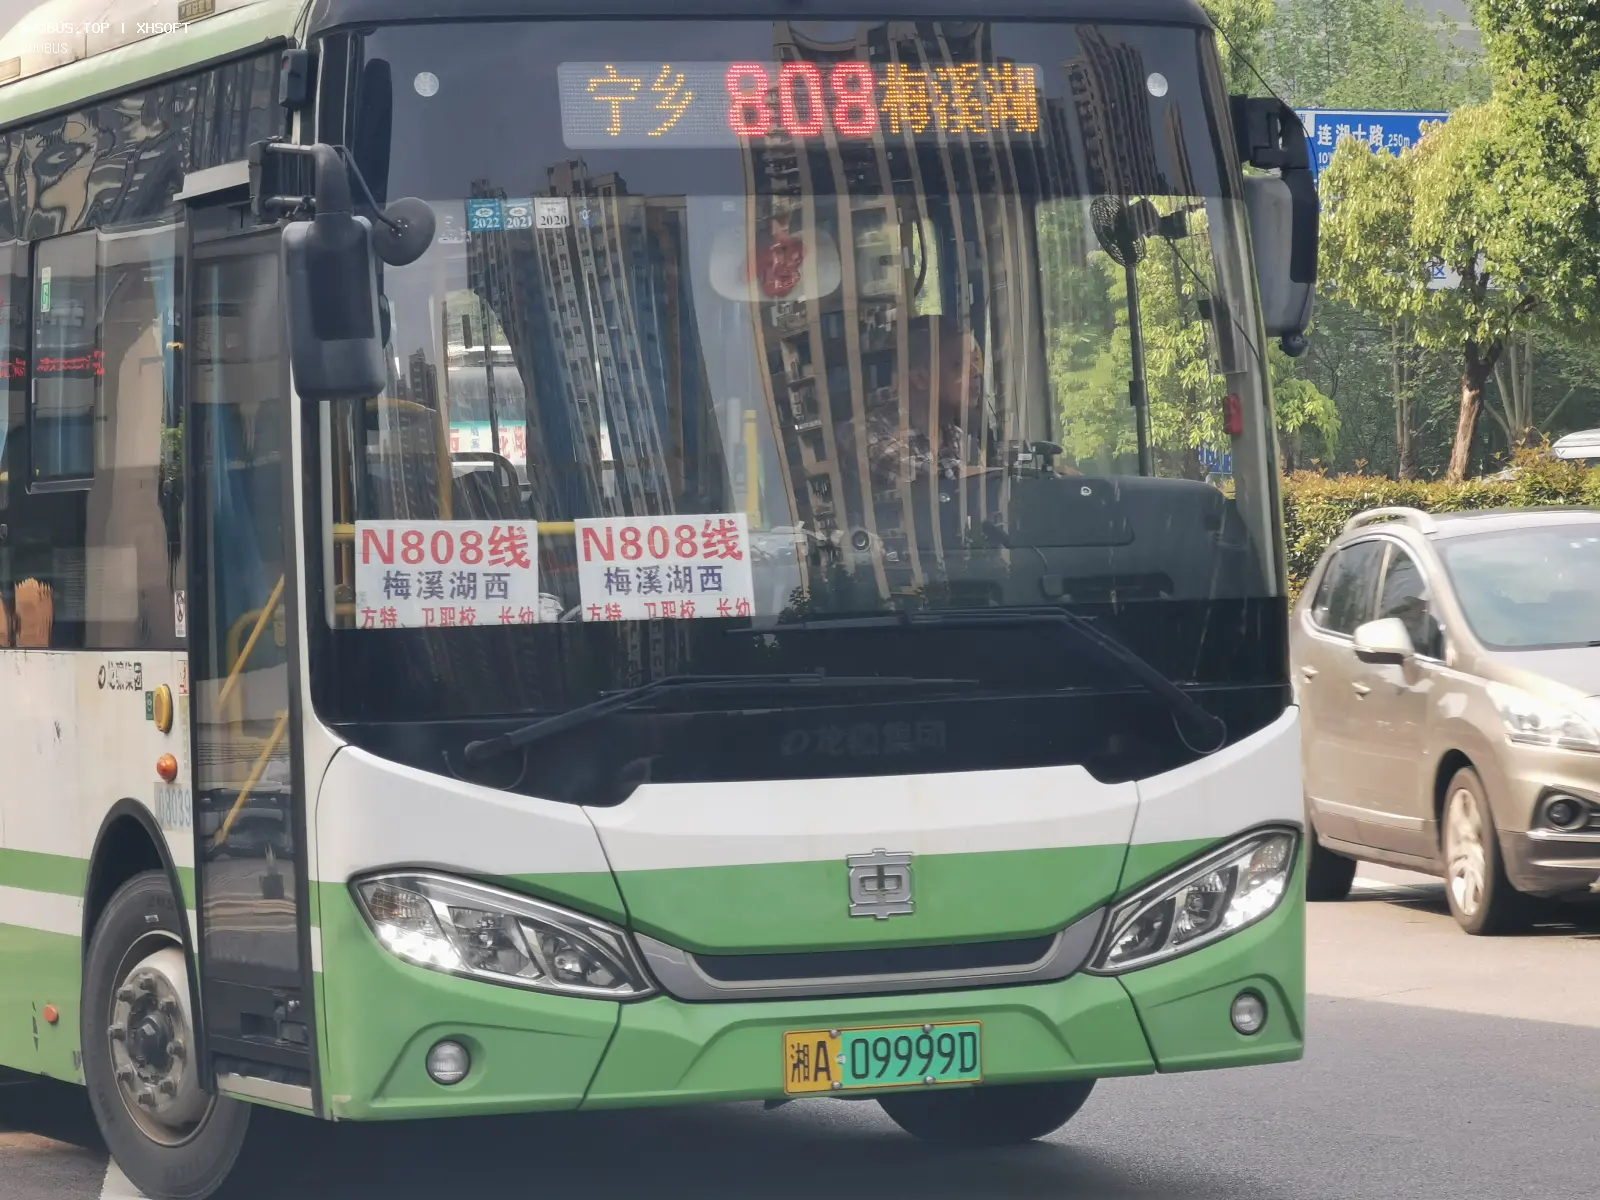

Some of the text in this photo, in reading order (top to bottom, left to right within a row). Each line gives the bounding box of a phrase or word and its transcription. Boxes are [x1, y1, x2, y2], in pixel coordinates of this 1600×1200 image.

[586, 61, 1038, 137] 宁乡 808 梅溪湖
[1387, 133, 1411, 147] 250m
[472, 217, 500, 229] 2022
[506, 216, 533, 229] 2021
[540, 214, 567, 226] 2020
[361, 525, 531, 569] N808线
[581, 518, 744, 562] N808线
[382, 570, 511, 601] 梅溪湖西
[603, 564, 724, 597] 梅溪湖西
[790, 1031, 978, 1082] 湘A 09999D
